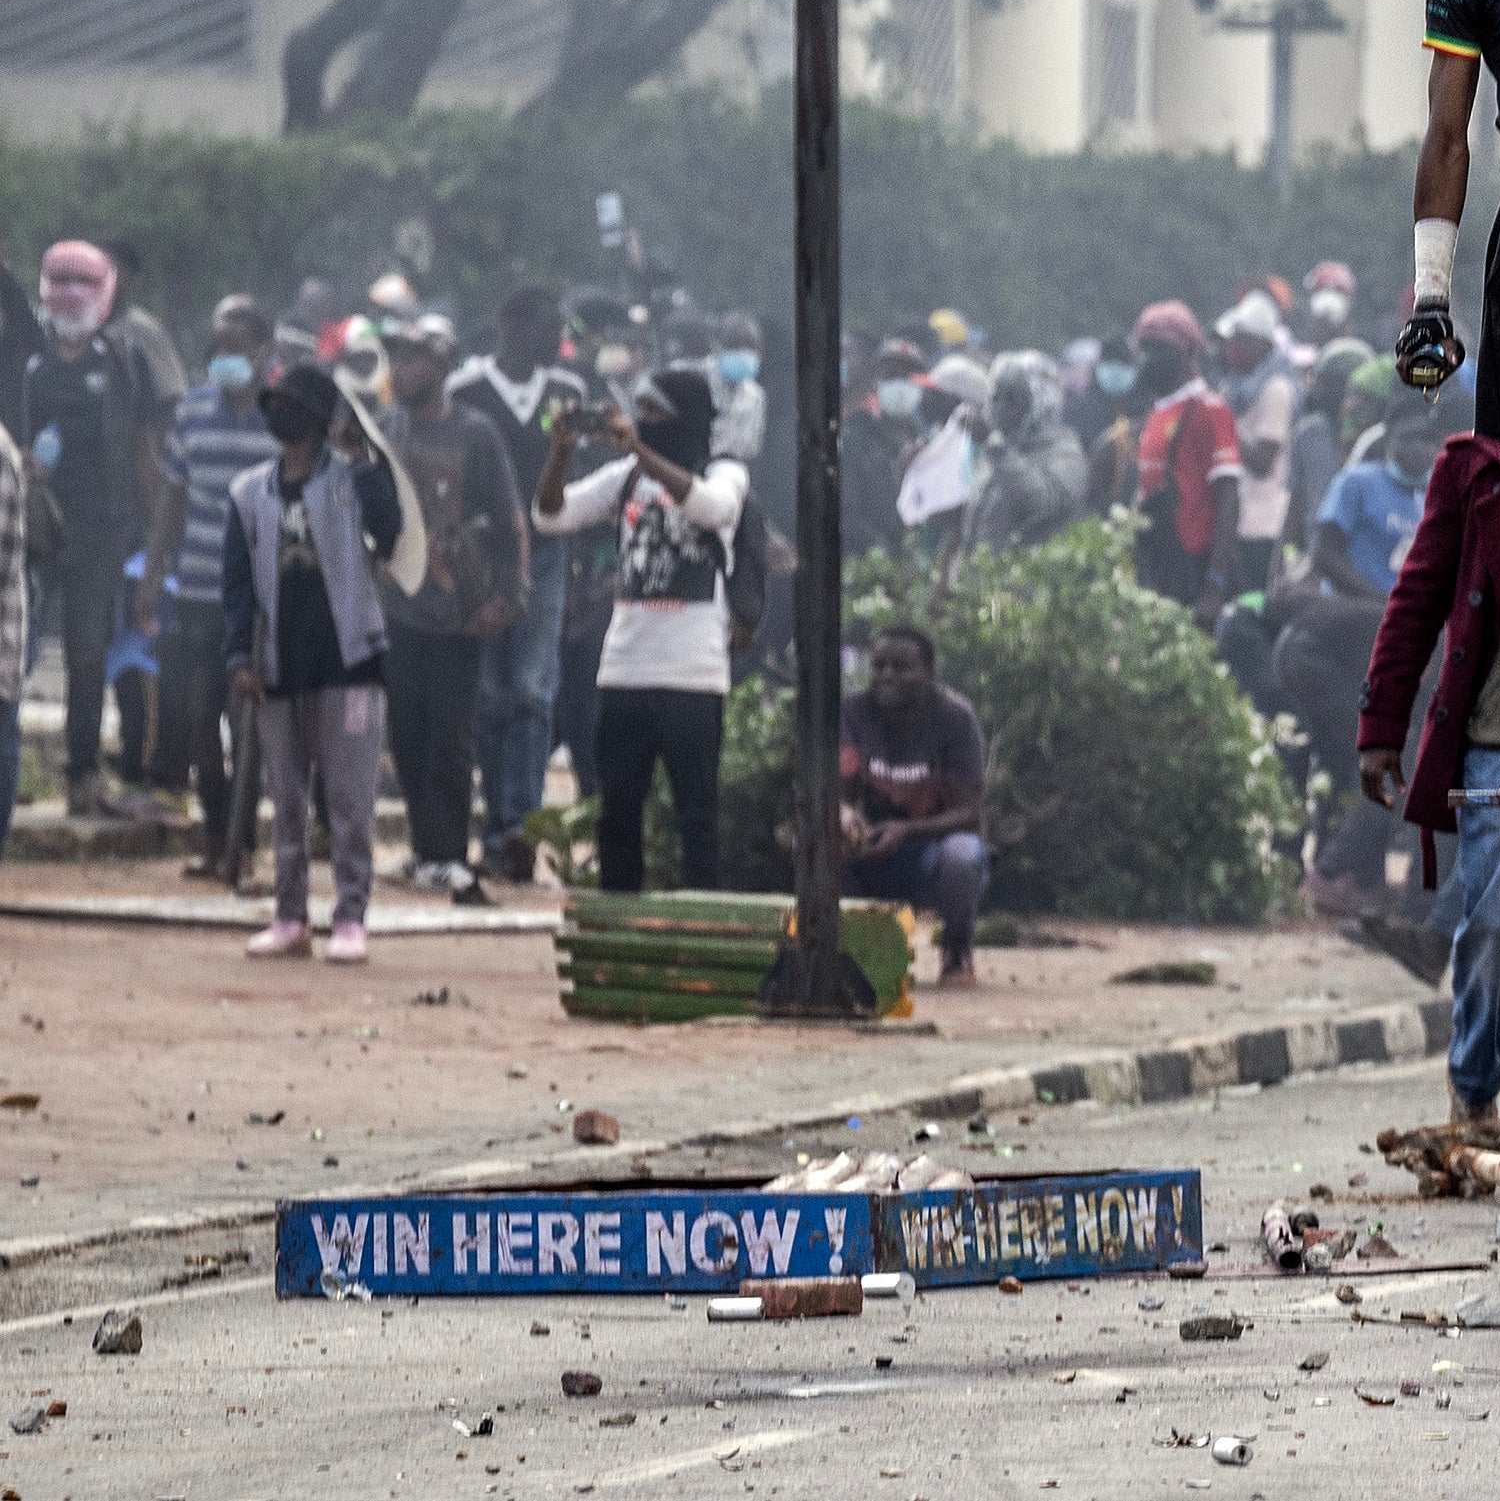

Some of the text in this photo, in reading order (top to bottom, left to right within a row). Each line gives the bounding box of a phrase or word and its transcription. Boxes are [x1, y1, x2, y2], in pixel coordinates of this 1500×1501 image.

[310, 1211, 431, 1276] WIN
[451, 1211, 622, 1276] HERE
[644, 1208, 801, 1276] NOW
[899, 1204, 972, 1270] WIN
[974, 1195, 1068, 1262] HERE
[1075, 1188, 1161, 1259] NOW
